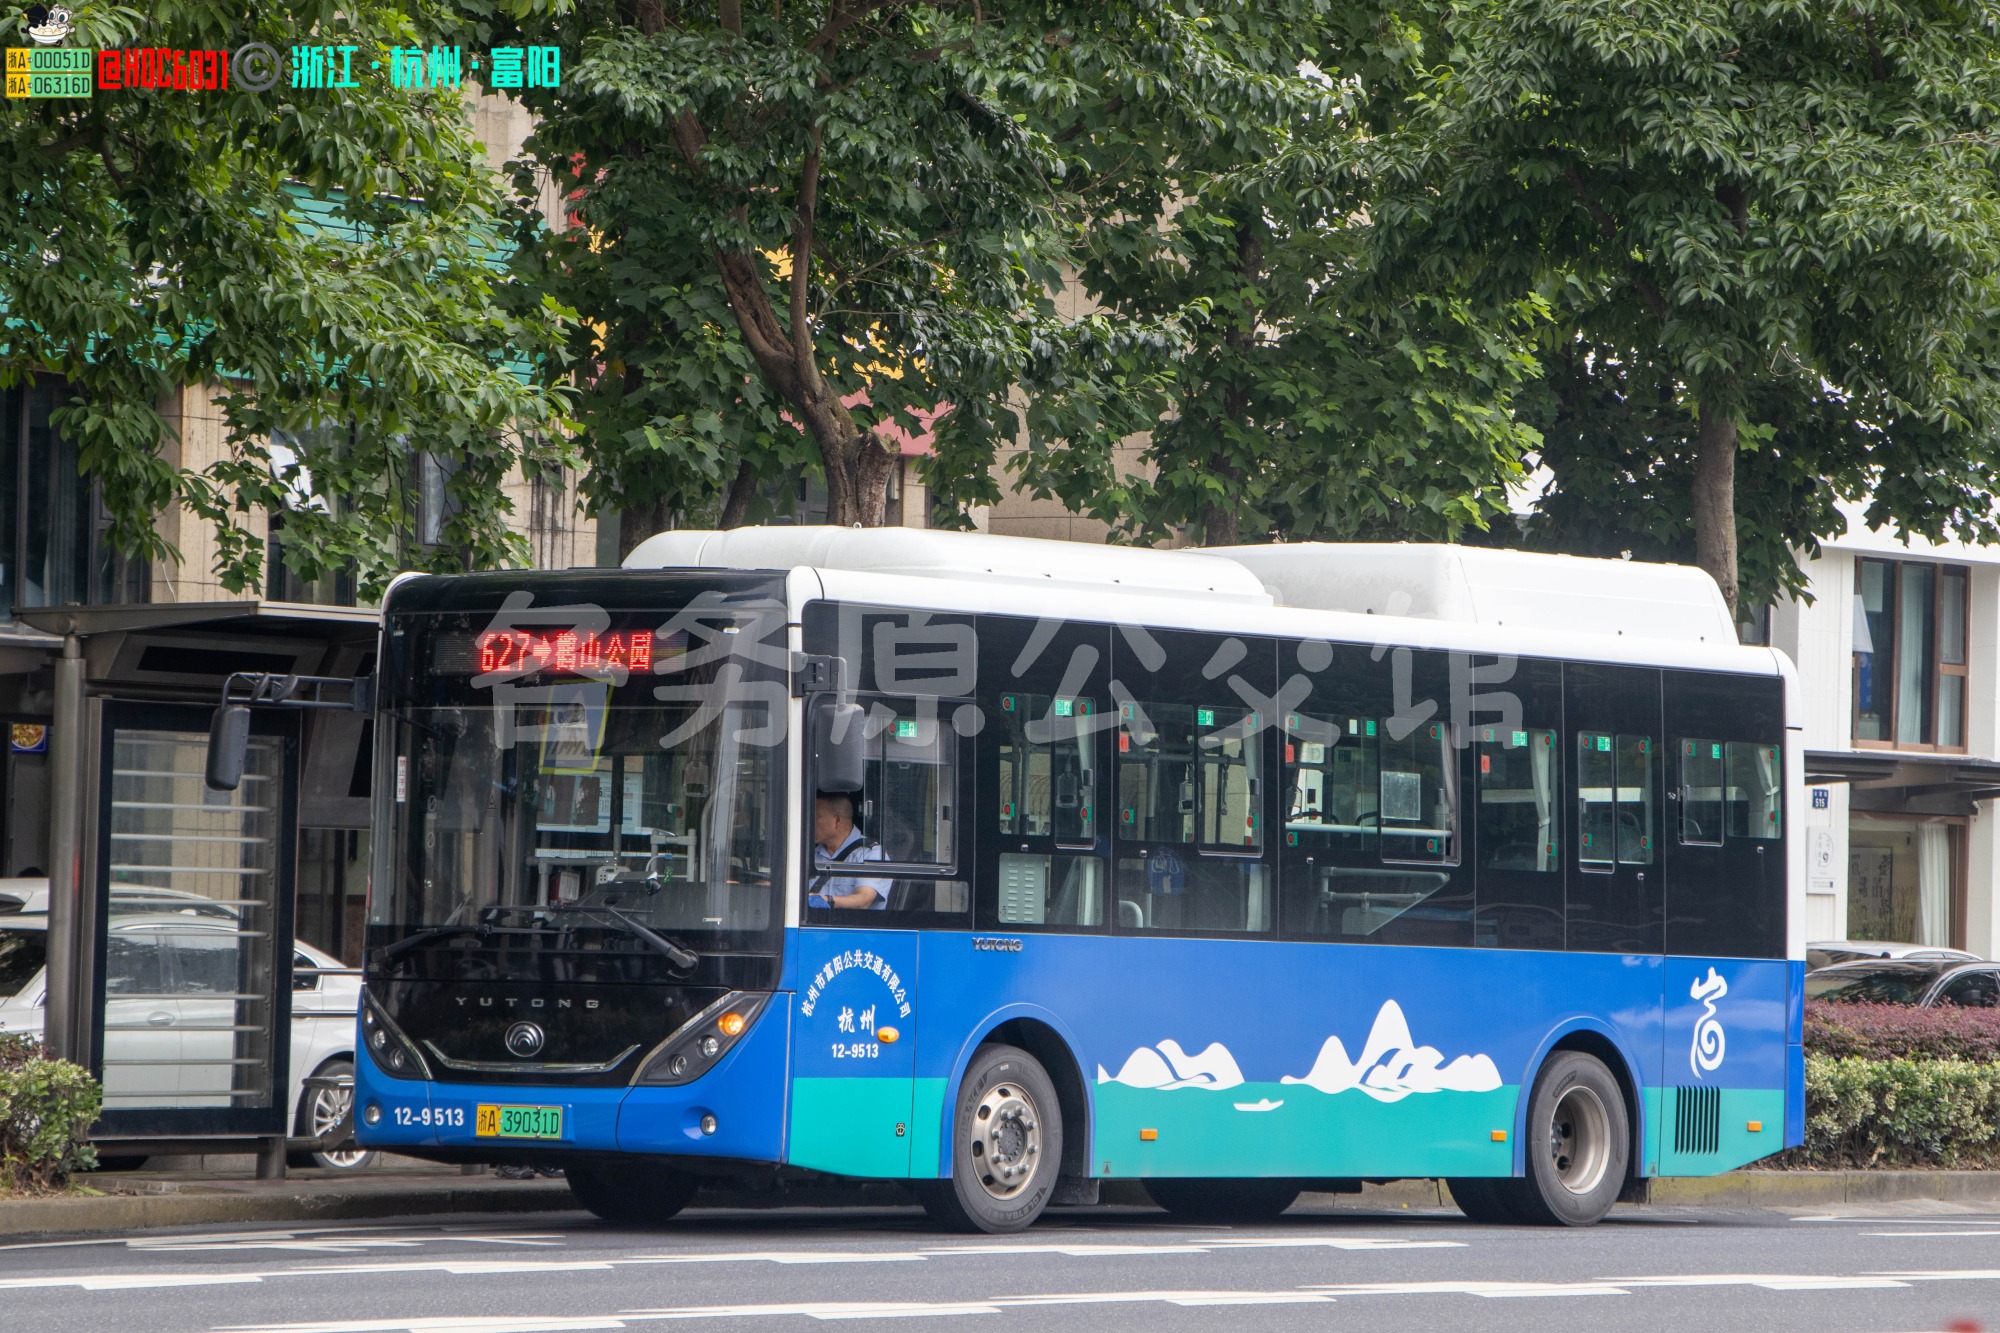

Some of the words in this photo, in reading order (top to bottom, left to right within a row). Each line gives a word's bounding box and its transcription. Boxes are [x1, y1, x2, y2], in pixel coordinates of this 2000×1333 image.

[481, 633, 531, 671] 627
[1815, 797, 1826, 807] 515
[971, 937, 1023, 952] YUTONG
[801, 949, 911, 1018] 杭州市富阳公共交通有限公司
[455, 997, 600, 1009] YUTONG
[837, 1004, 876, 1037] 杭州
[831, 1043, 879, 1058] 12-9513
[394, 1107, 464, 1127] 12-9513
